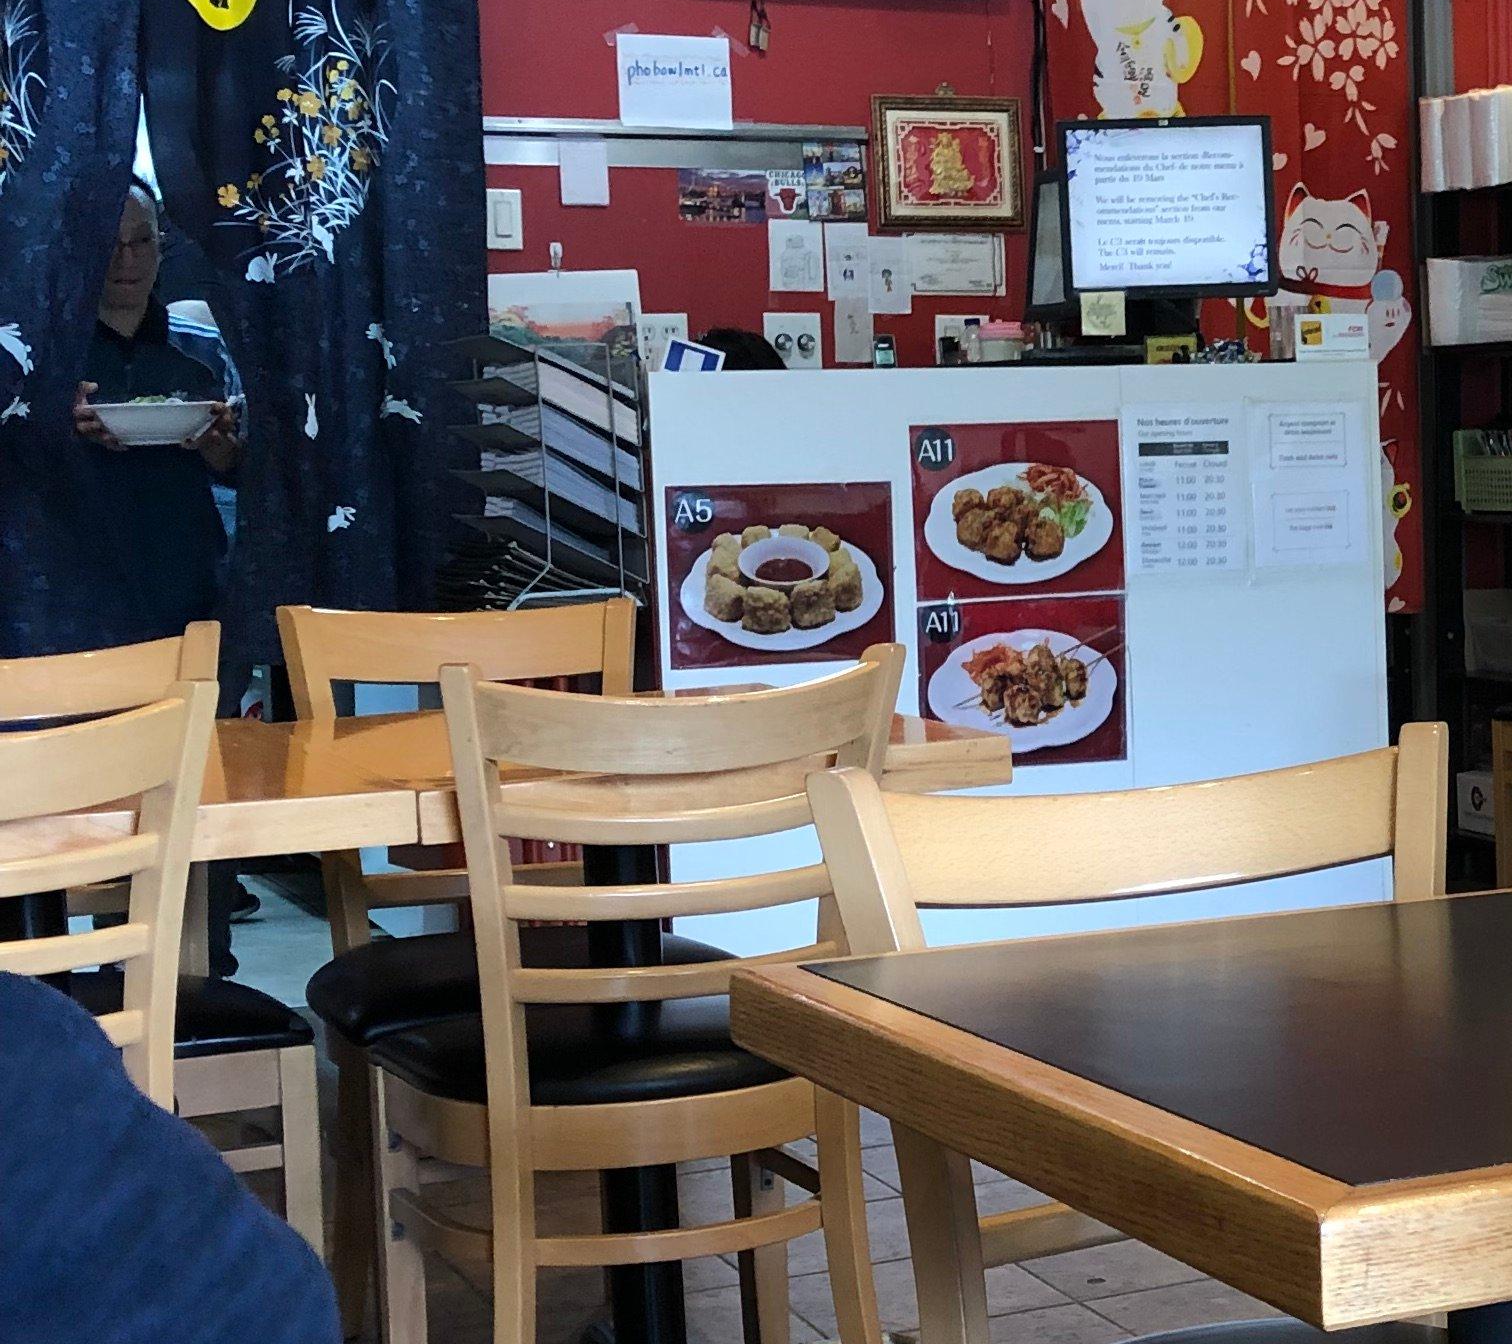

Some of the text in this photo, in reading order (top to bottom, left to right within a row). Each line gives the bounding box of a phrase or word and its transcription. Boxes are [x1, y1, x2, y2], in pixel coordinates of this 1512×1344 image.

[918, 439, 952, 462] A11
[675, 498, 712, 523] A5
[926, 611, 959, 633] A11
